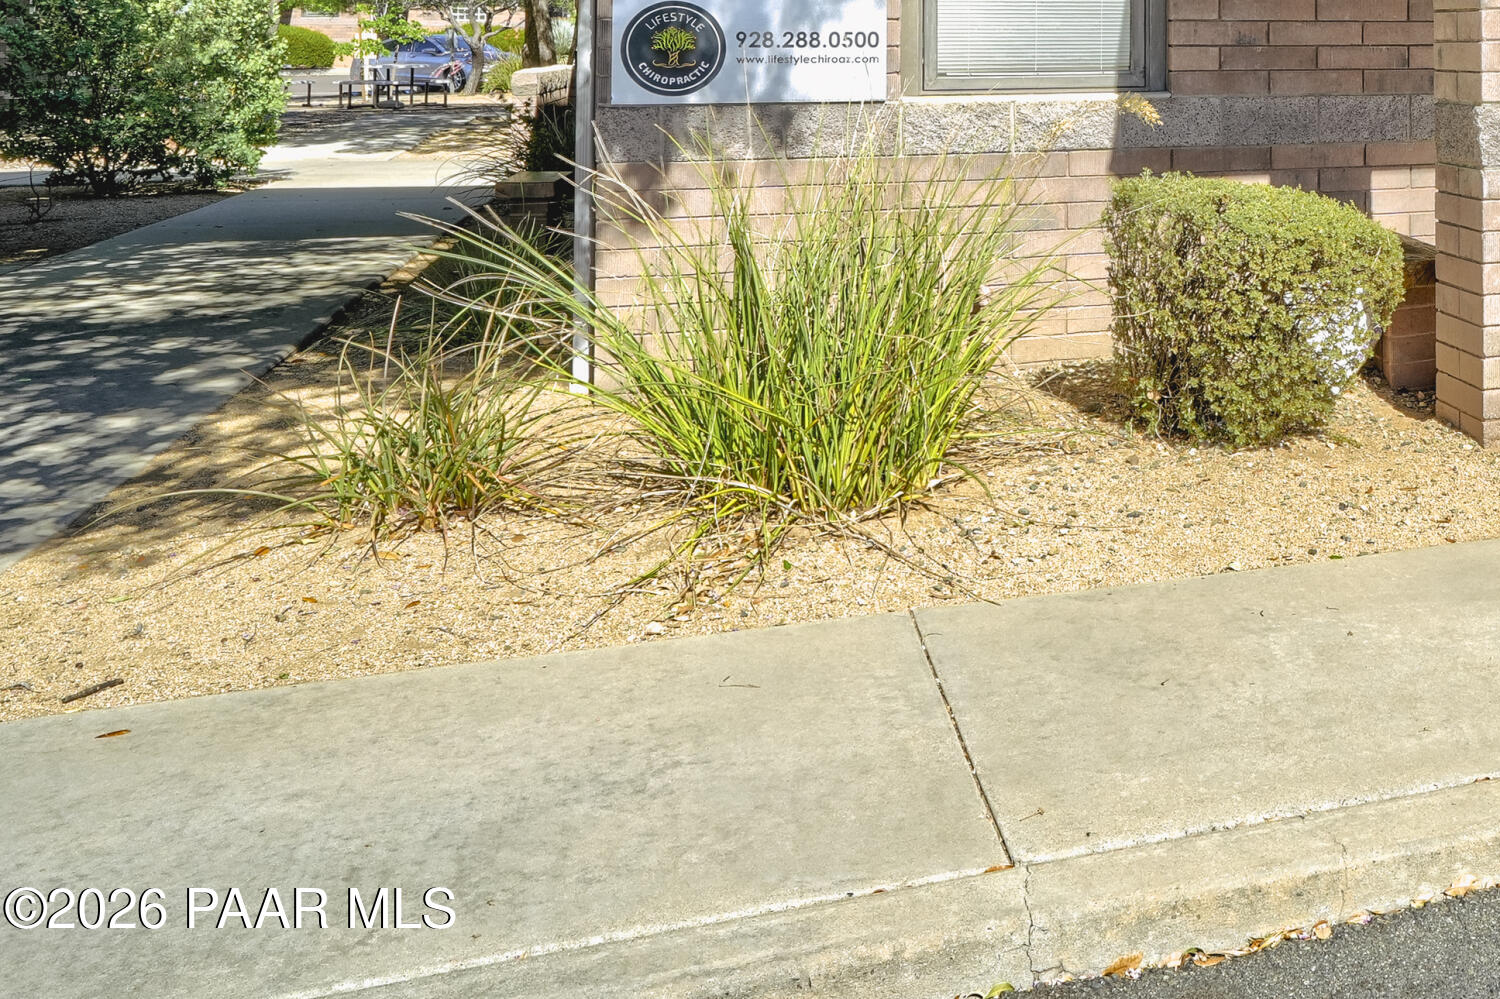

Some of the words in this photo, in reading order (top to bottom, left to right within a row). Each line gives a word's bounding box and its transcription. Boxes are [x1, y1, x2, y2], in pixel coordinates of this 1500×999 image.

[645, 12, 705, 33] LIFESTYLE
[736, 31, 880, 48] 928.288.0500
[736, 54, 880, 66] www.lifestylechiroaz.com
[638, 61, 710, 86] CHIROPRACTIC
